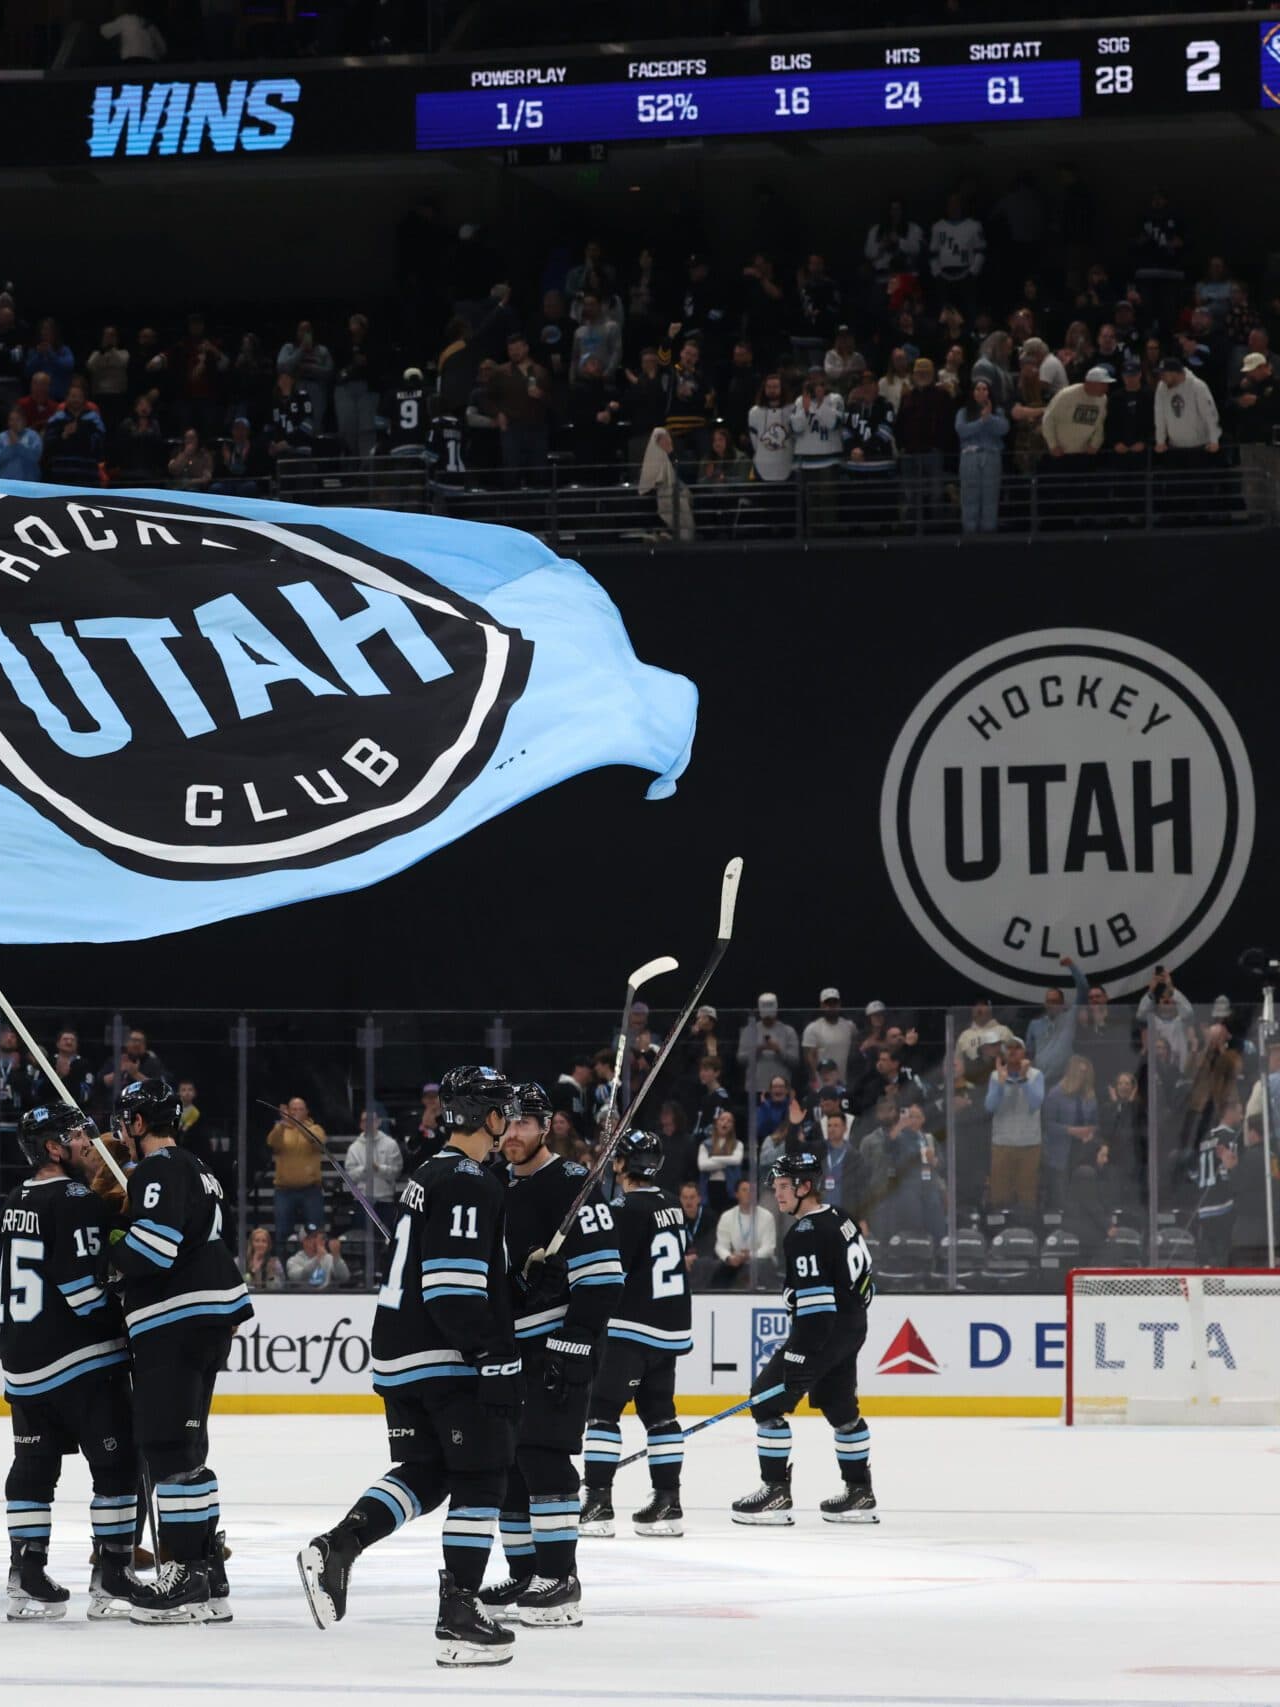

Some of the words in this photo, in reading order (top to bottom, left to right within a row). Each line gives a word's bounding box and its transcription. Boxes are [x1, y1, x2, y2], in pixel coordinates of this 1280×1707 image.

[886, 48, 920, 64] HITS
[970, 44, 1010, 60] SHOT
[1013, 42, 1041, 57] ATT
[1098, 37, 1130, 53] SOG
[629, 59, 706, 78] FACEOFFS
[771, 54, 811, 70] BLKS
[1186, 40, 1220, 92] 2
[471, 70, 525, 87] POWER
[527, 67, 567, 84] PLAY
[988, 76, 1024, 104] 61
[1096, 66, 1132, 94] 28
[638, 93, 698, 123] 52%
[775, 87, 810, 115] 16
[885, 81, 921, 109] 24
[86, 78, 301, 157] WINS
[497, 99, 543, 131] 1/5
[400, 400, 418, 429] 9
[967, 675, 1172, 741] HOCKEY
[185, 738, 399, 827] CLUB
[943, 757, 1193, 882] UTAH
[1003, 912, 1137, 958] CLUB
[144, 1182, 162, 1209] 6
[449, 1205, 478, 1239] 11
[577, 1202, 614, 1235] 28
[73, 1226, 102, 1258] 15
[795, 1254, 820, 1278] 91
[970, 1323, 1237, 1370] DELTA
